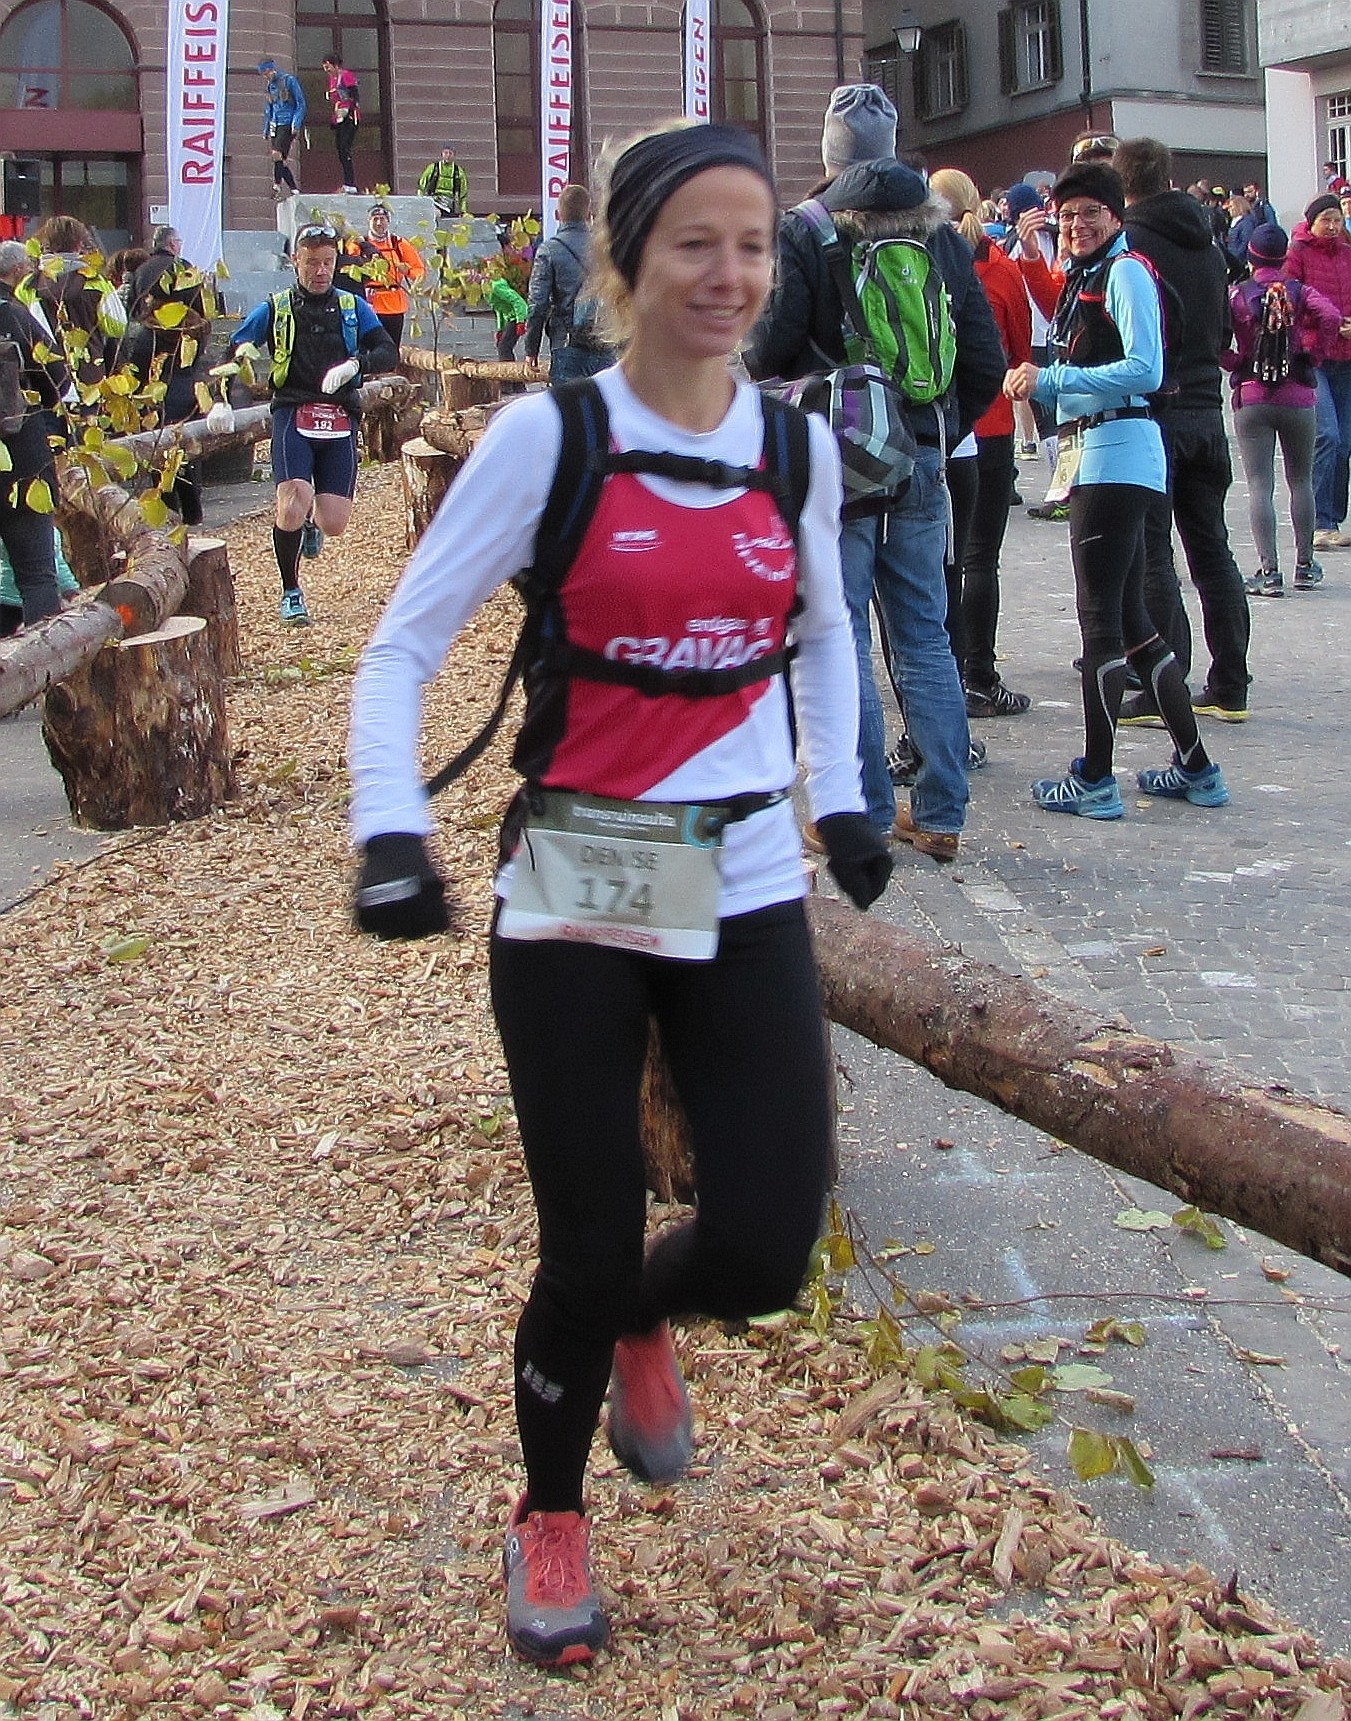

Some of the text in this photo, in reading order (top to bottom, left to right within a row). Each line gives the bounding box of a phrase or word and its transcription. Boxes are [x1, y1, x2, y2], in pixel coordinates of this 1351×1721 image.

[181, 2, 218, 184] RAIFFEIS
[548, 0, 572, 198] RAIFFEISE
[574, 879, 654, 915] 174
[580, 844, 658, 870] DENSE
